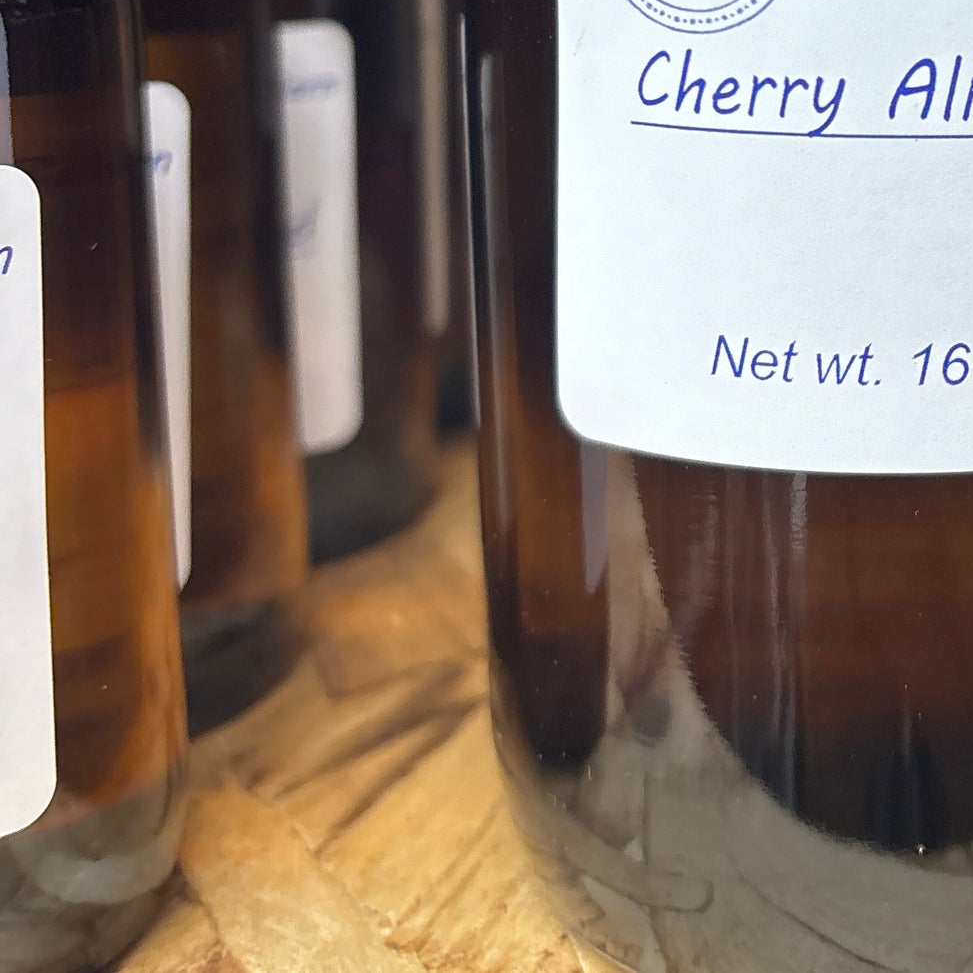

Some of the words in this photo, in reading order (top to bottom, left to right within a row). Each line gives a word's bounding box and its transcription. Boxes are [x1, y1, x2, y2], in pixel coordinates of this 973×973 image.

[637, 48, 847, 138] Cherry
[711, 334, 798, 382] Net
[816, 342, 882, 386] wt.
[912, 342, 971, 386] 16
